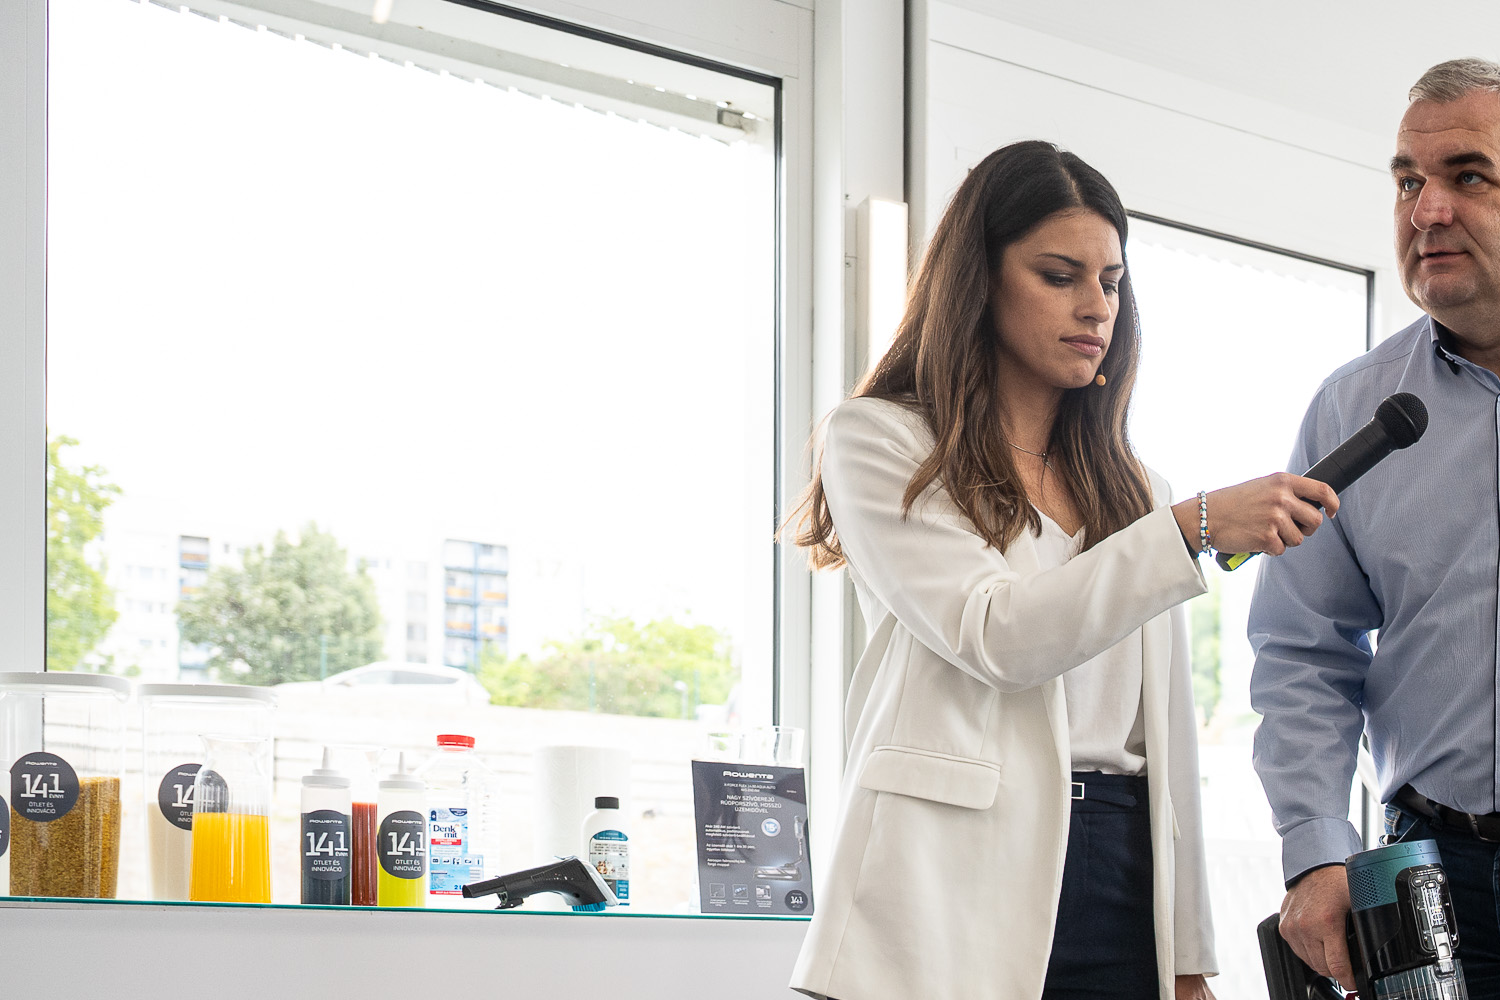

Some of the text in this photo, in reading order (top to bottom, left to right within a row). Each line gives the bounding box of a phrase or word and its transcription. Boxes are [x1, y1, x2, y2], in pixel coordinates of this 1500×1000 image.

[722, 770, 774, 780] Rowenta
[20, 773, 65, 798] 141
[433, 824, 456, 833] Denk
[444, 831, 458, 839] mit
[305, 831, 349, 857] 141
[387, 831, 426, 857] 141
